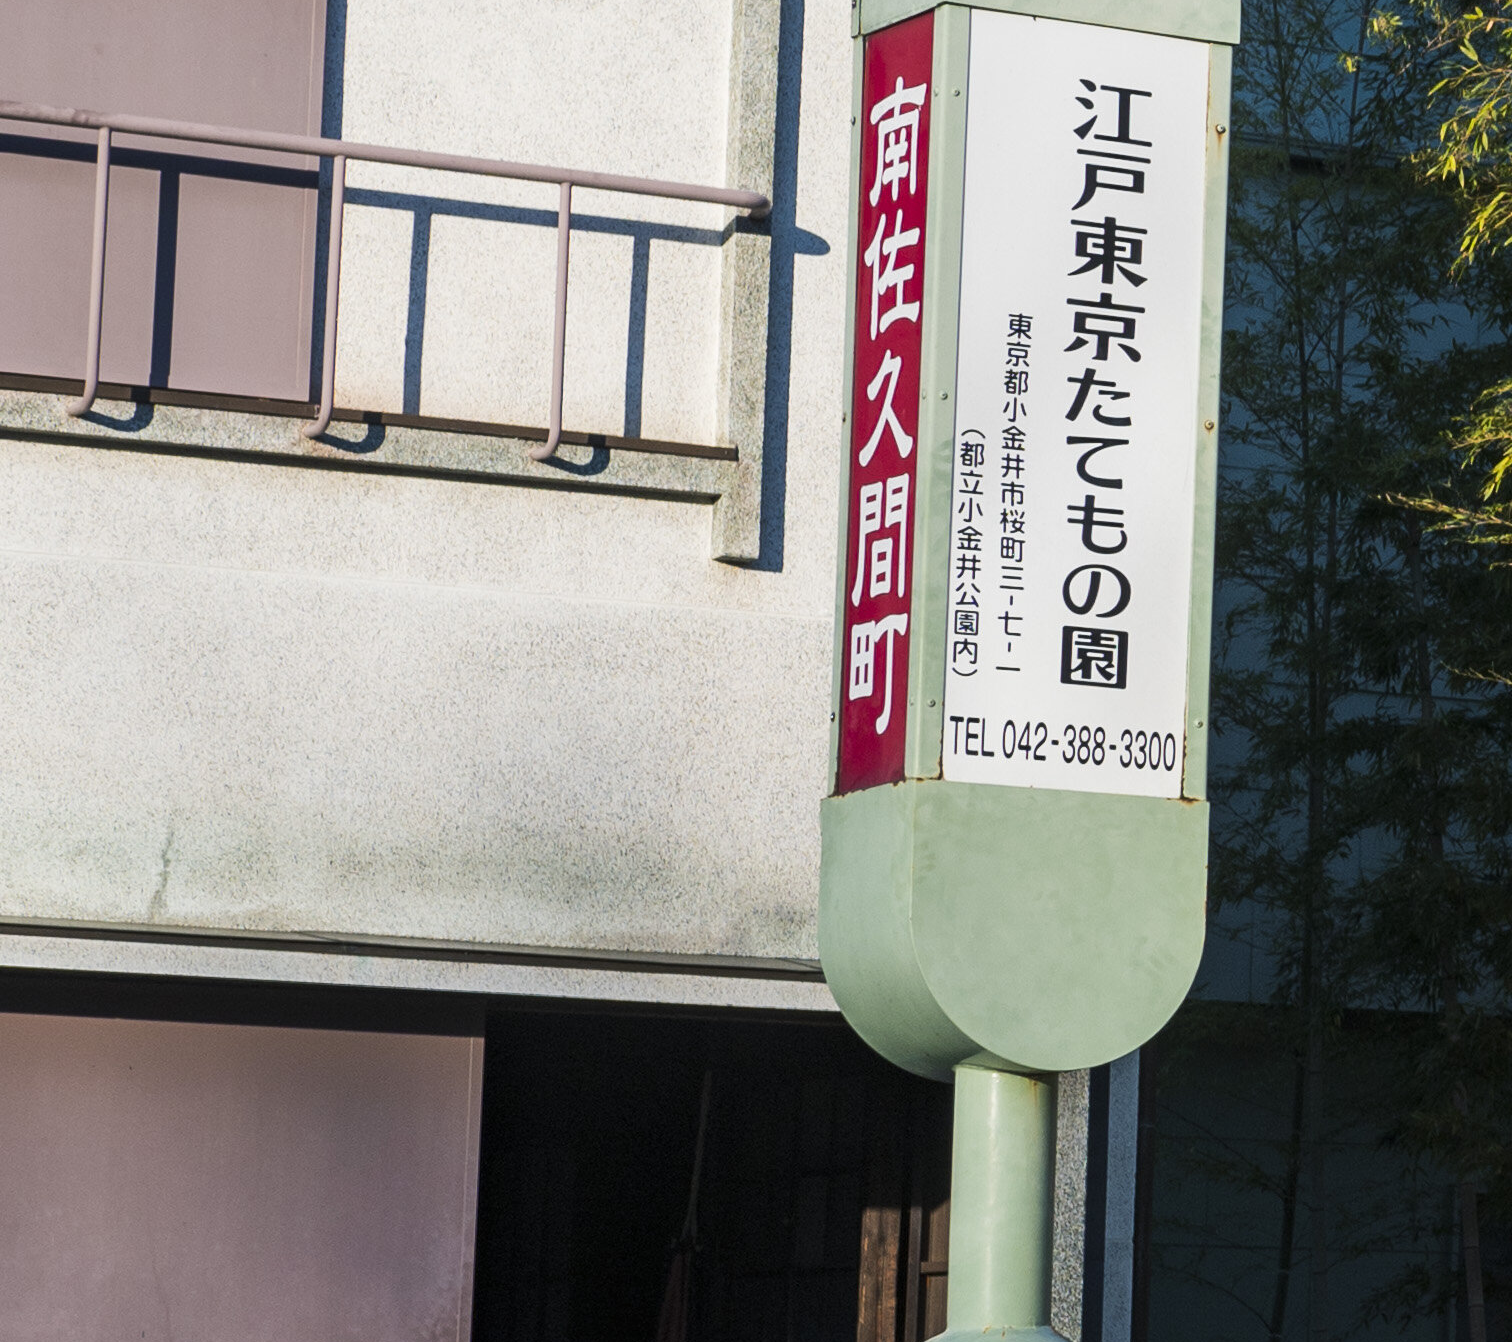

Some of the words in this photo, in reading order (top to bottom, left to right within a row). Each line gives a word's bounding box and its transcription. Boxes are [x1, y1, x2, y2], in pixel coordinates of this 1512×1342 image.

[848, 76, 927, 735] 南佐久間町
[1061, 79, 1153, 689] 江戸東京たてもの園
[949, 715, 994, 757] TEL
[1002, 719, 1177, 771] 042-388-3300
